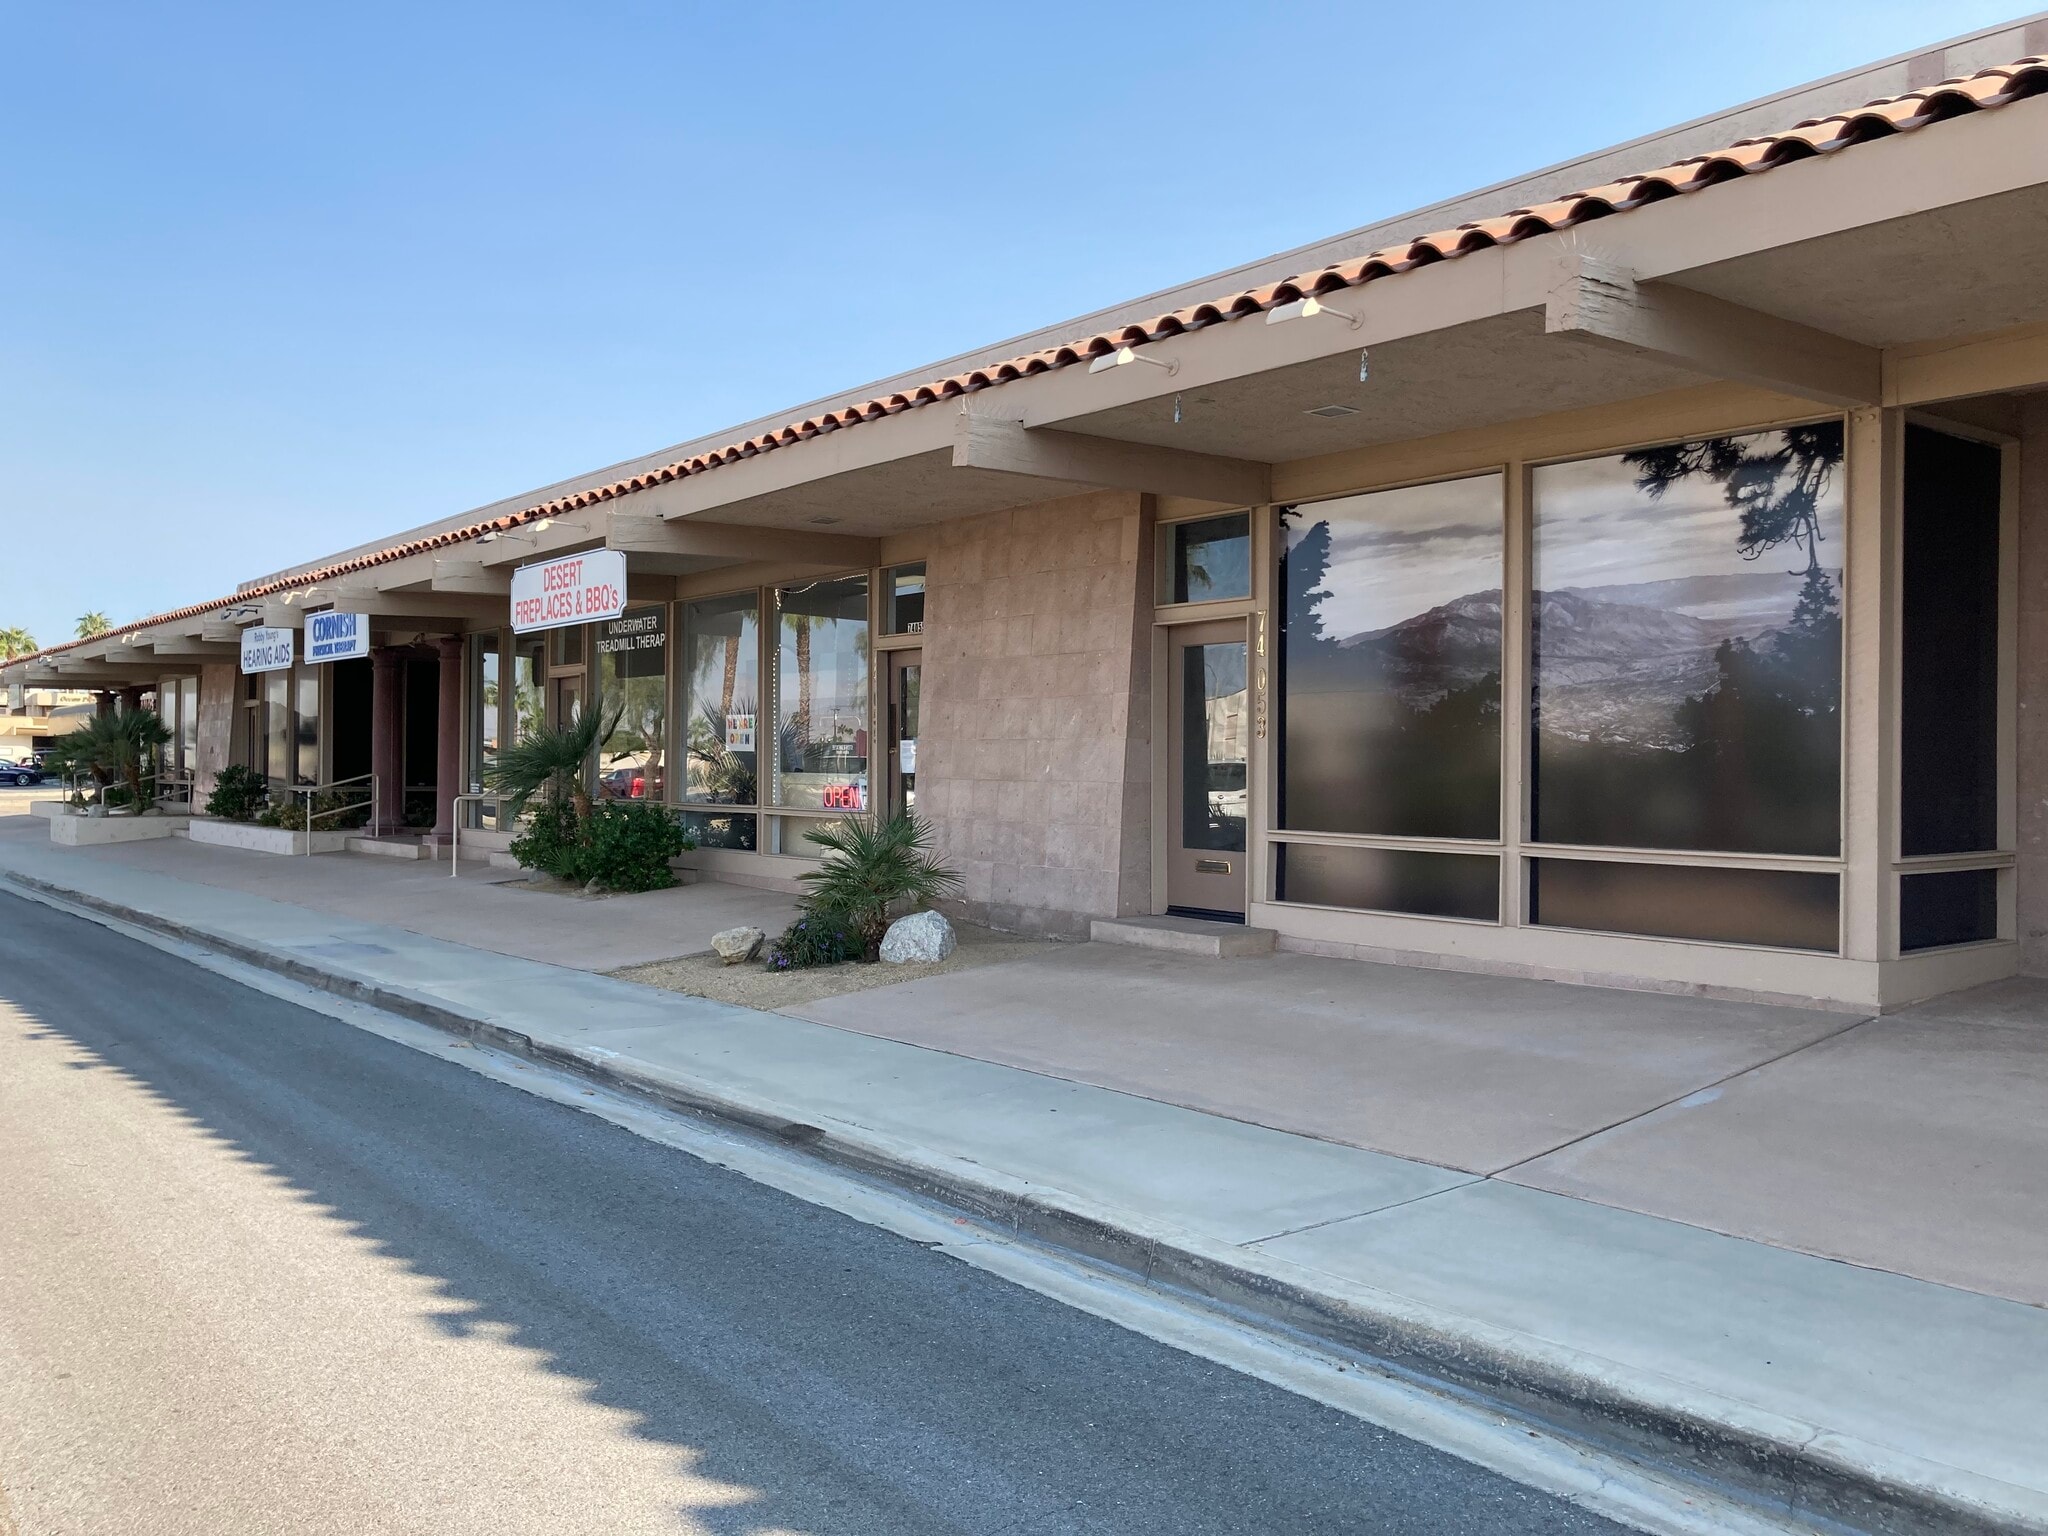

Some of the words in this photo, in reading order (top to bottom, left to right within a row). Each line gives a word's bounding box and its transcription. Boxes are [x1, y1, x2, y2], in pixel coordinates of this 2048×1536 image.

[543, 560, 583, 592] DESERT
[515, 591, 572, 625] FIREPLACES
[575, 590, 582, 615] &
[585, 583, 618, 613] BBQ's
[312, 613, 357, 642] CORNISH
[608, 615, 657, 634] UNDERWATER
[243, 646, 272, 669] HEARING
[274, 643, 290, 665] AIDS
[596, 637, 635, 654] TREADMILL
[727, 719, 738, 730] WE
[738, 717, 753, 729] ARE
[730, 733, 750, 745] OPEN
[823, 786, 860, 808] OPEN
